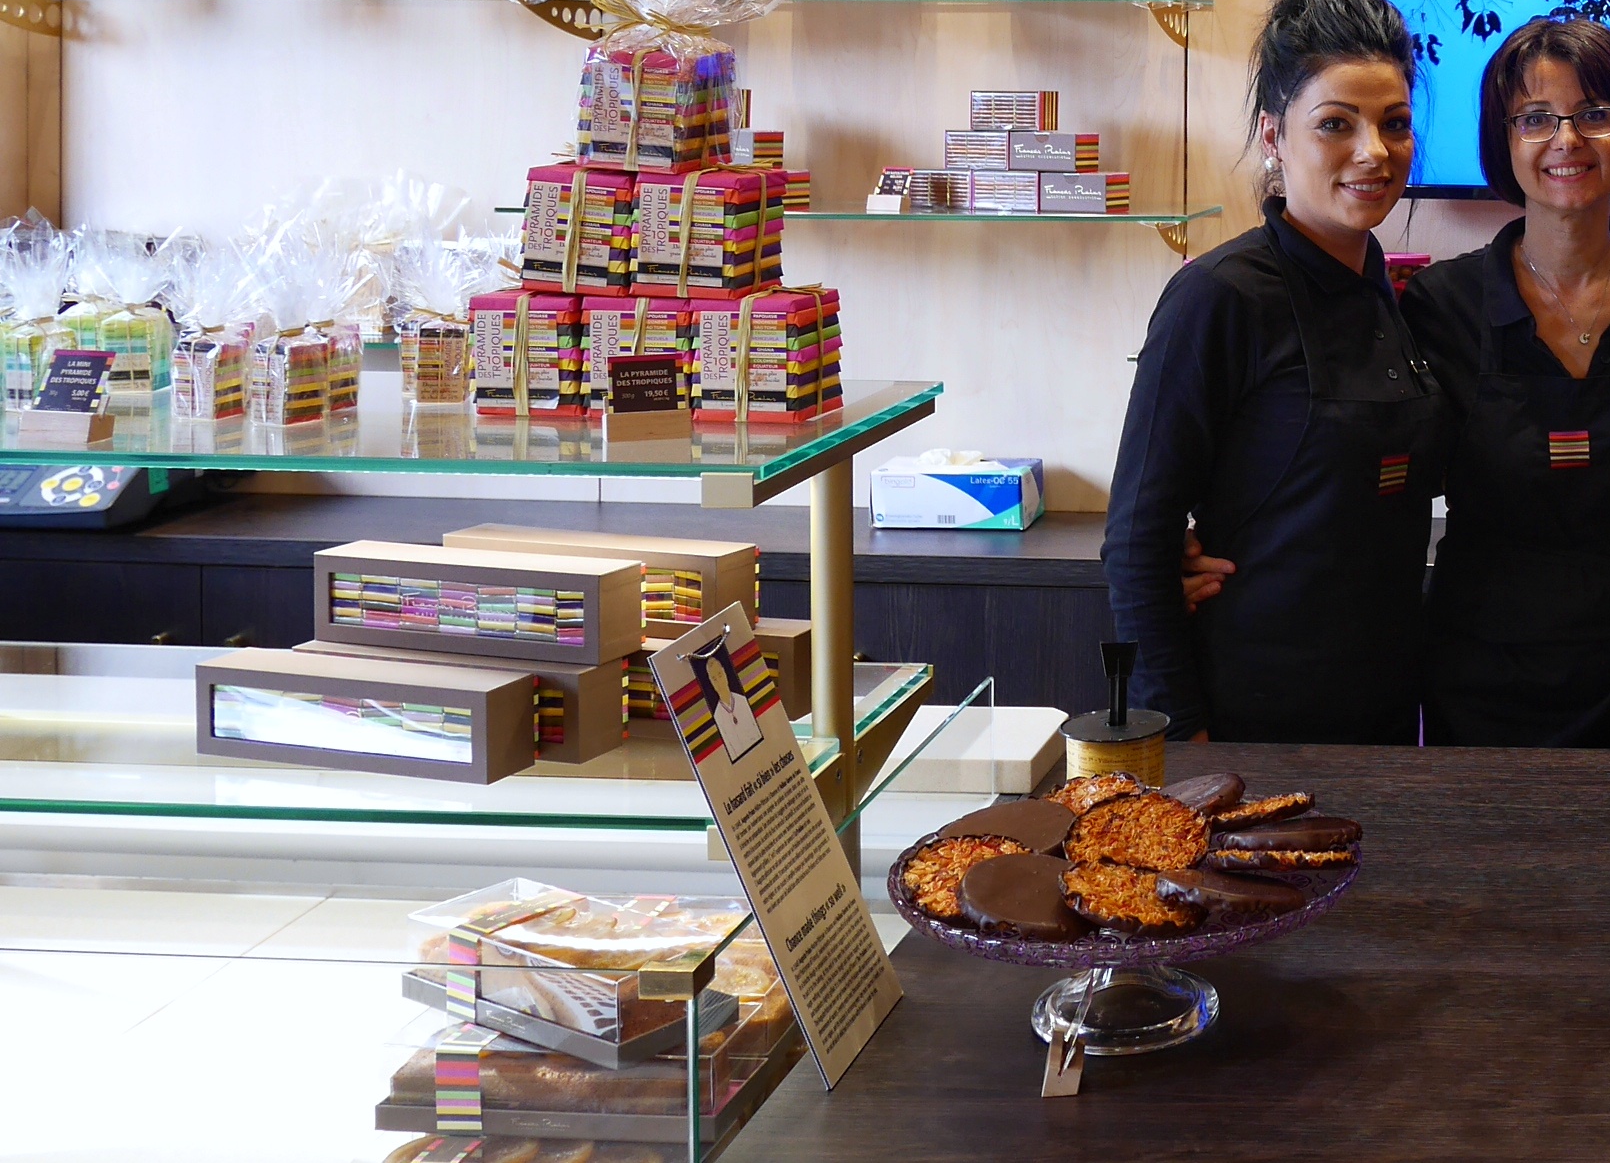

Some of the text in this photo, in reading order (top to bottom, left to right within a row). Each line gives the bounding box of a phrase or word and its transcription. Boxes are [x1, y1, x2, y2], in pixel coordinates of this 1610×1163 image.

[718, 314, 729, 380] TROPIQUES
[631, 369, 669, 378] PYRAMIDE
[63, 377, 98, 385] TROPIQUES
[632, 377, 673, 386] TROPIQUES
[785, 930, 804, 953] Chance
[800, 916, 815, 937] made
[810, 904, 827, 925] things
